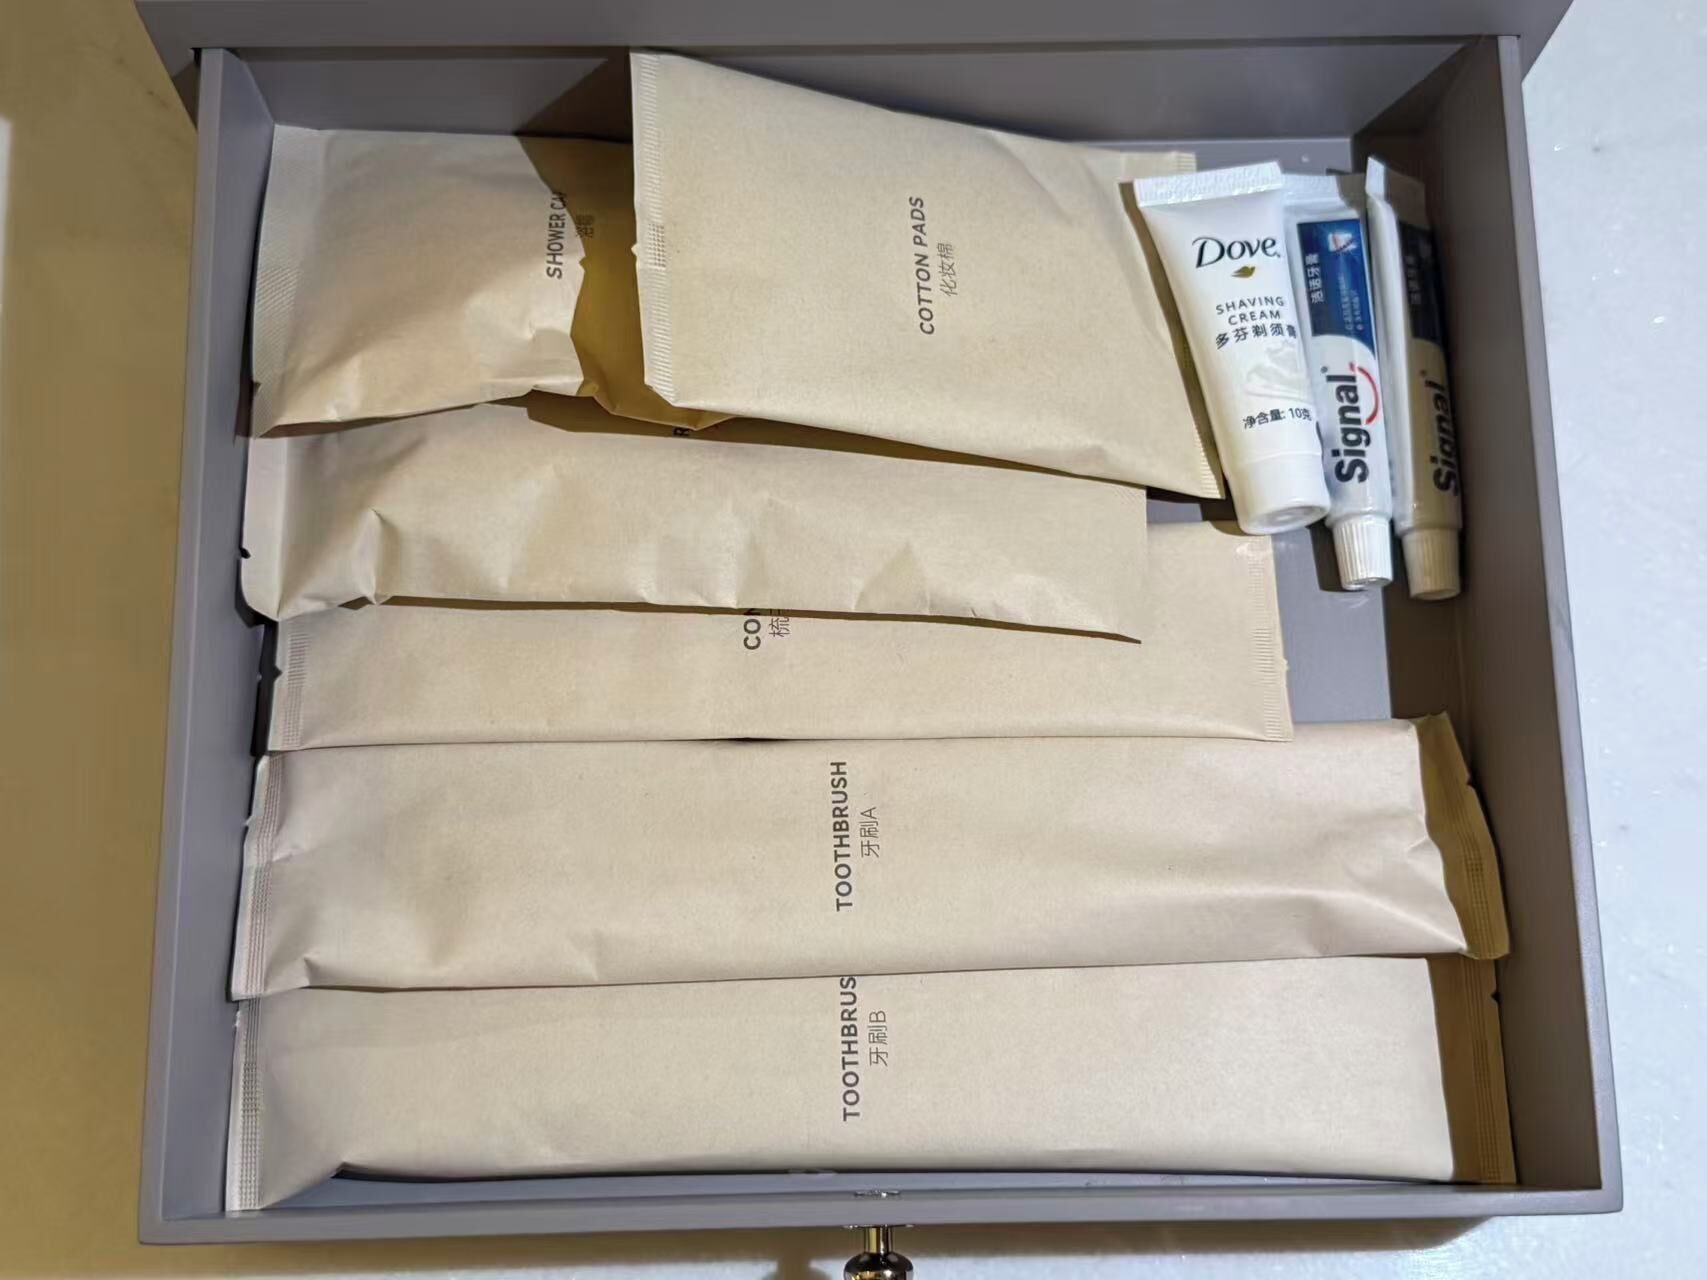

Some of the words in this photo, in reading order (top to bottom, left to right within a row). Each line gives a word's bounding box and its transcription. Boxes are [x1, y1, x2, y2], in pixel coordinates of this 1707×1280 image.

[546, 213, 566, 279] SHOWER
[908, 196, 928, 247] PADS
[936, 242, 958, 297] 化妆棉
[1192, 236, 1279, 269] Dove
[914, 253, 935, 335] COTTON
[1215, 296, 1285, 315] SHAVING
[1228, 310, 1281, 326] CREAM
[1215, 322, 1297, 350] 多芬剃须膏
[1326, 374, 1371, 483] Signal
[1424, 379, 1459, 497] Signal
[830, 761, 853, 912] TOOTHBRUSH
[860, 806, 881, 859] 牙刷A
[867, 1010, 889, 1067] 牙刷B
